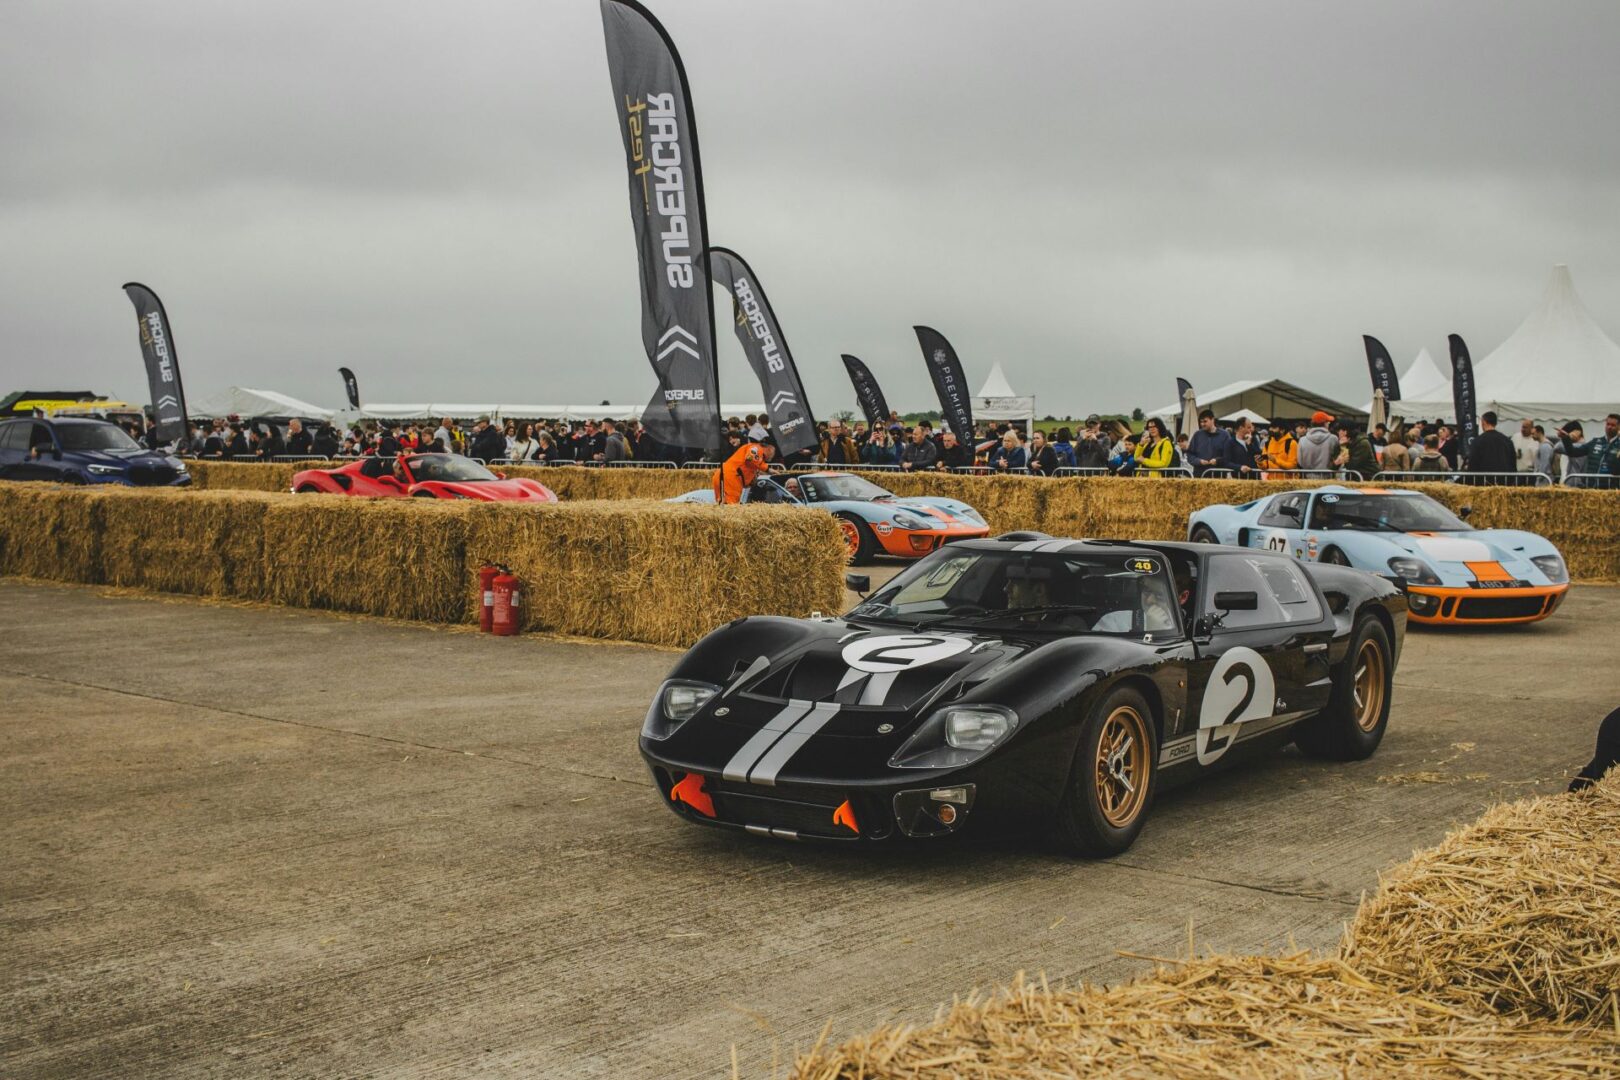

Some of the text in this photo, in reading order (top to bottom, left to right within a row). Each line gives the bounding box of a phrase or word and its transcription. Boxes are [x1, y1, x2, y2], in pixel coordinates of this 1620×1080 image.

[942, 366, 968, 425] PREMIER
[1135, 561, 1152, 570] 40
[858, 637, 946, 666] 2
[1204, 661, 1256, 755] 2
